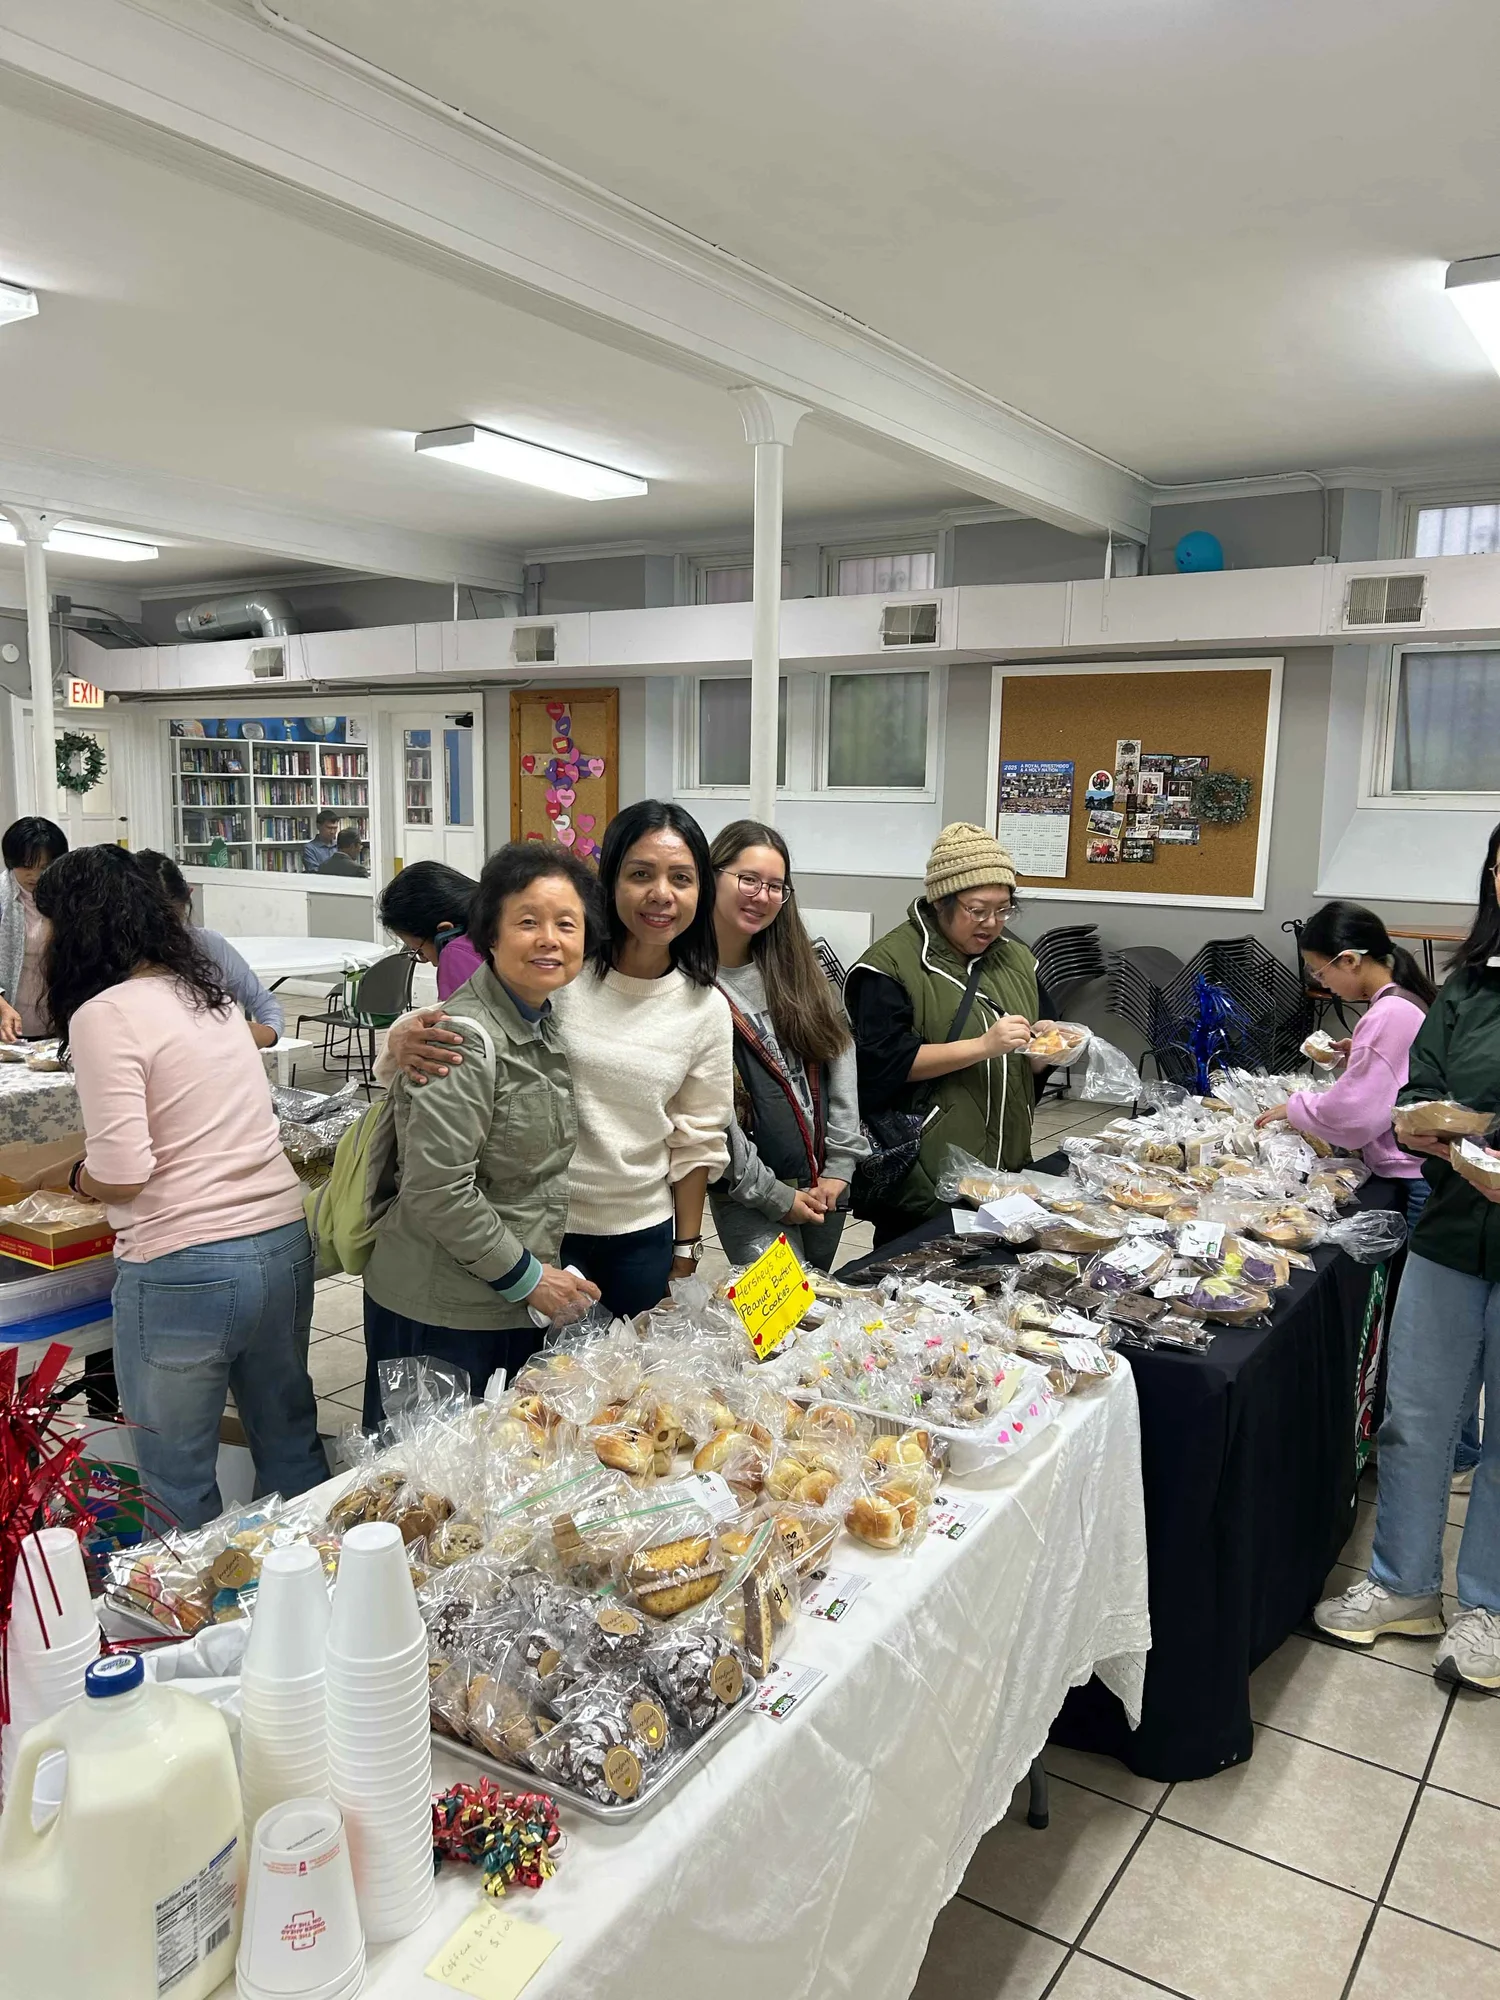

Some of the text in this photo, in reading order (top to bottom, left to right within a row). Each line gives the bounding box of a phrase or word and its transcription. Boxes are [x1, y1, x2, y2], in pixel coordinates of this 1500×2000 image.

[72, 682, 99, 704] EXIT
[736, 1260, 774, 1302] Hershey's
[739, 1261, 793, 1320] Peanut Butter
[761, 1284, 791, 1316] Cookies
[772, 1583, 789, 1608] $3
[156, 1878, 198, 1911] Nutrition Facts
[280, 1921, 326, 1935] ORDER AHEAD
[312, 1917, 322, 1925] ON
